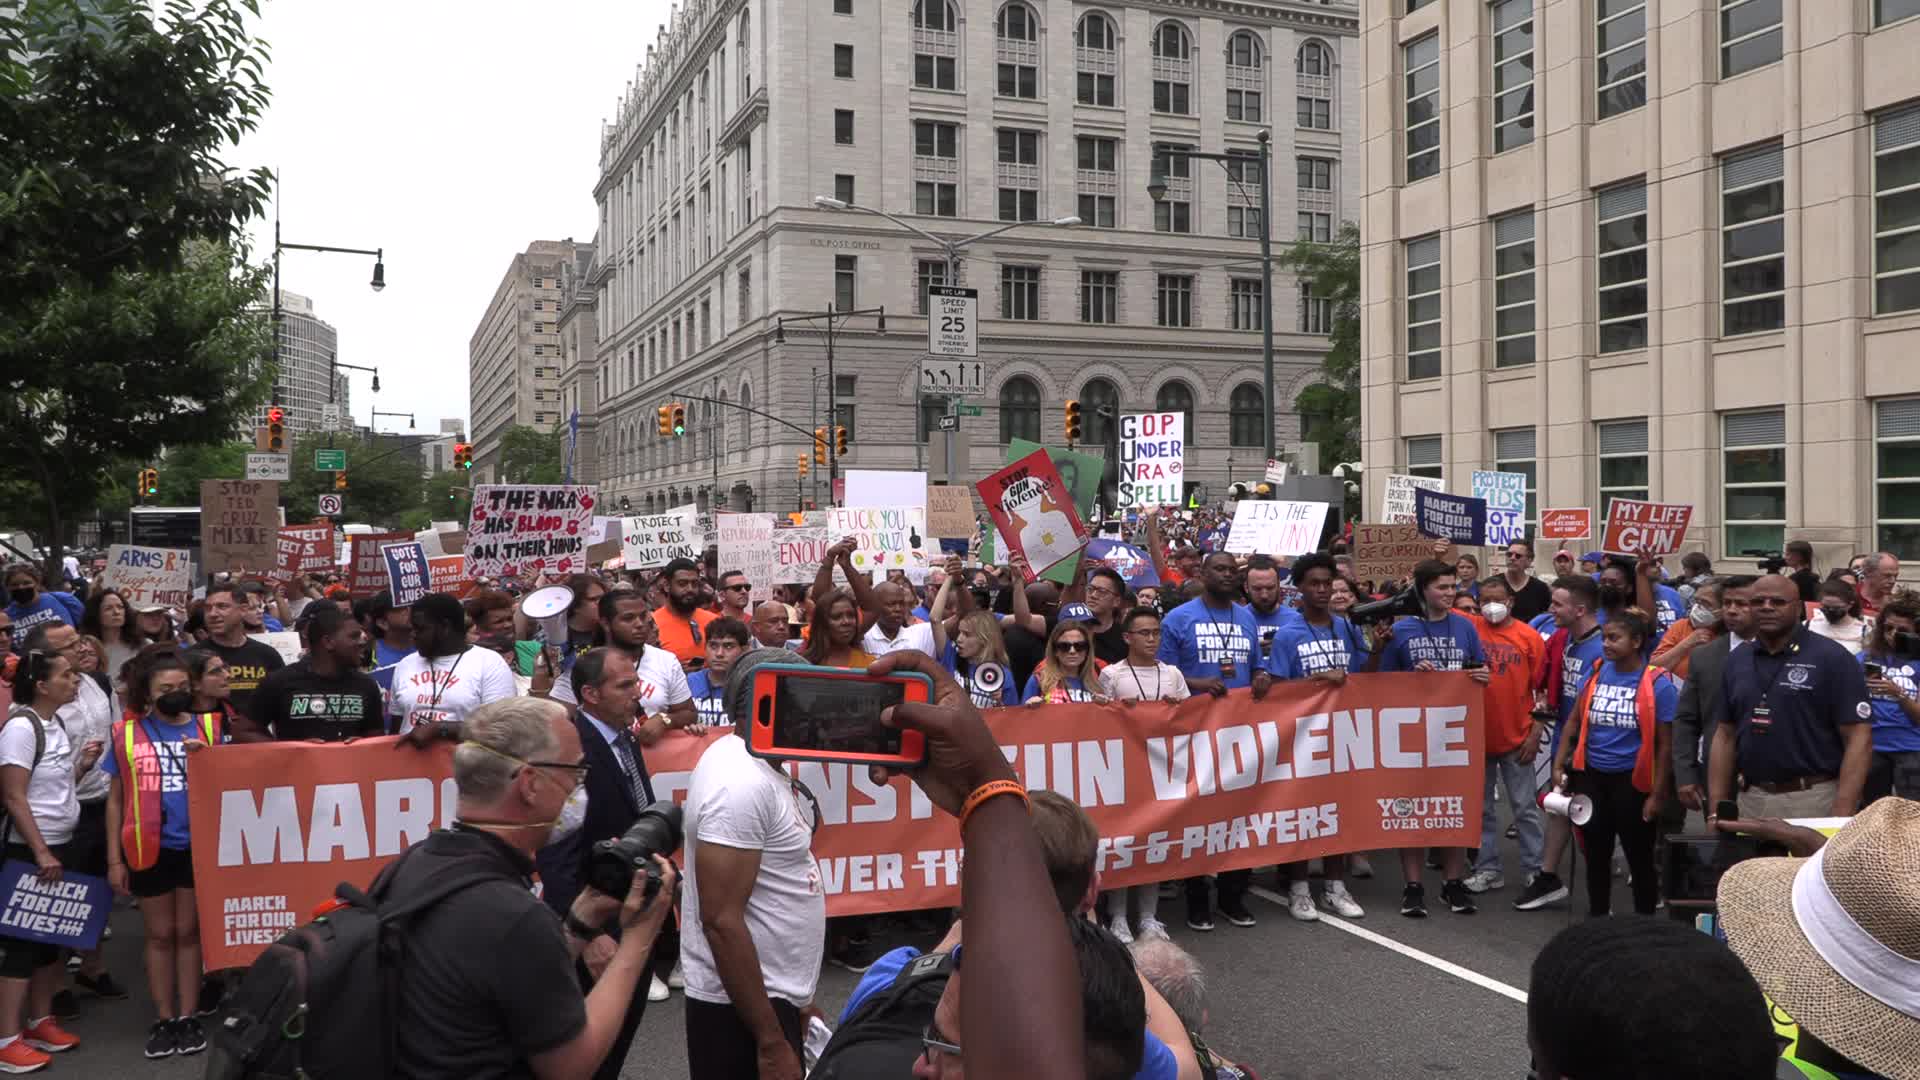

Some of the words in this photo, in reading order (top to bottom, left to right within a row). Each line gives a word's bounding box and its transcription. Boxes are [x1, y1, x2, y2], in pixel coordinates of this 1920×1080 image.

[827, 240, 849, 249] POST
[852, 241, 881, 250] OFFICE
[941, 298, 967, 307] SPEED
[944, 306, 964, 314] LIMIT
[942, 316, 965, 333] 25
[325, 414, 338, 423] 25
[1120, 440, 1182, 462] UNDER
[999, 466, 1030, 490] STOP
[1119, 463, 1164, 482] NRA
[1472, 471, 1525, 490] PROTECT
[220, 482, 263, 495] STOP
[1009, 479, 1030, 497] GUN
[1388, 476, 1402, 489] THE
[1403, 478, 1420, 489] ONLY
[1421, 480, 1441, 491] THING
[225, 497, 255, 509] TED
[488, 490, 535, 511] THE
[537, 490, 577, 510] NRA
[1388, 489, 1407, 500] EASIER
[1473, 488, 1524, 512] KIDS
[1286, 503, 1312, 520] THE
[1387, 502, 1405, 513] THAN
[1405, 504, 1411, 513] A
[1423, 496, 1465, 516] MARCH
[1615, 502, 1645, 520] MY
[1648, 504, 1688, 523] LIFE
[222, 511, 259, 526] CRUZ
[484, 515, 514, 534] HAS
[517, 515, 563, 533] BLOOD
[633, 516, 683, 530] PROTECT
[837, 510, 879, 530] FUCK
[880, 509, 906, 531] YOU
[1386, 513, 1392, 523] A
[1423, 508, 1445, 524] FOR
[1445, 515, 1473, 528] OUR
[1490, 511, 1518, 526] OT
[1360, 528, 1393, 544] I'M
[1424, 520, 1453, 538] LIVES
[1488, 527, 1522, 544] UNS
[631, 533, 654, 546] OUR
[658, 530, 685, 544] KIDS
[1617, 527, 1676, 554] GUN
[391, 546, 419, 561] VOTE
[473, 544, 498, 560] ON
[503, 540, 547, 559] THEIR
[549, 537, 583, 556] HANDS
[640, 548, 666, 563] NOT
[666, 544, 694, 559] GUNS
[1359, 546, 1377, 560] OF
[1381, 544, 1434, 558] CARRYIN
[116, 549, 164, 570] ARMS
[179, 551, 188, 569] 4
[399, 560, 419, 575] FOR
[1359, 563, 1394, 577] SIGNS
[401, 574, 422, 588] OUR
[399, 587, 426, 604] LIVES
[1195, 623, 1243, 636] MARCH
[1196, 637, 1223, 650] FOR
[1225, 637, 1251, 650] OUR
[1297, 640, 1345, 657] MARCH
[1408, 636, 1457, 650] MARCH
[1199, 650, 1235, 664] LIVES
[1300, 654, 1324, 671] FOR
[1410, 648, 1437, 661] FOR
[230, 666, 266, 678] PHA
[410, 669, 461, 690] YOUTH
[417, 694, 443, 705] OVER
[133, 741, 187, 758] MARC
[1146, 706, 1470, 801] VIOLENCE
[1376, 796, 1464, 818] YOUTH
[217, 777, 458, 867] MAR
[1382, 818, 1420, 831] OVER
[1424, 817, 1465, 829] GUNS
[817, 854, 904, 895] VER
[1181, 803, 1339, 859] PRAYERS
[15, 873, 88, 900] MARCH
[8, 890, 52, 914] FOR
[50, 897, 92, 920] OUR
[224, 895, 287, 914] MARCH
[0, 909, 60, 935] LIVES
[224, 912, 261, 930] FOR
[261, 911, 297, 928] OUR
[225, 928, 274, 947] LIVES
